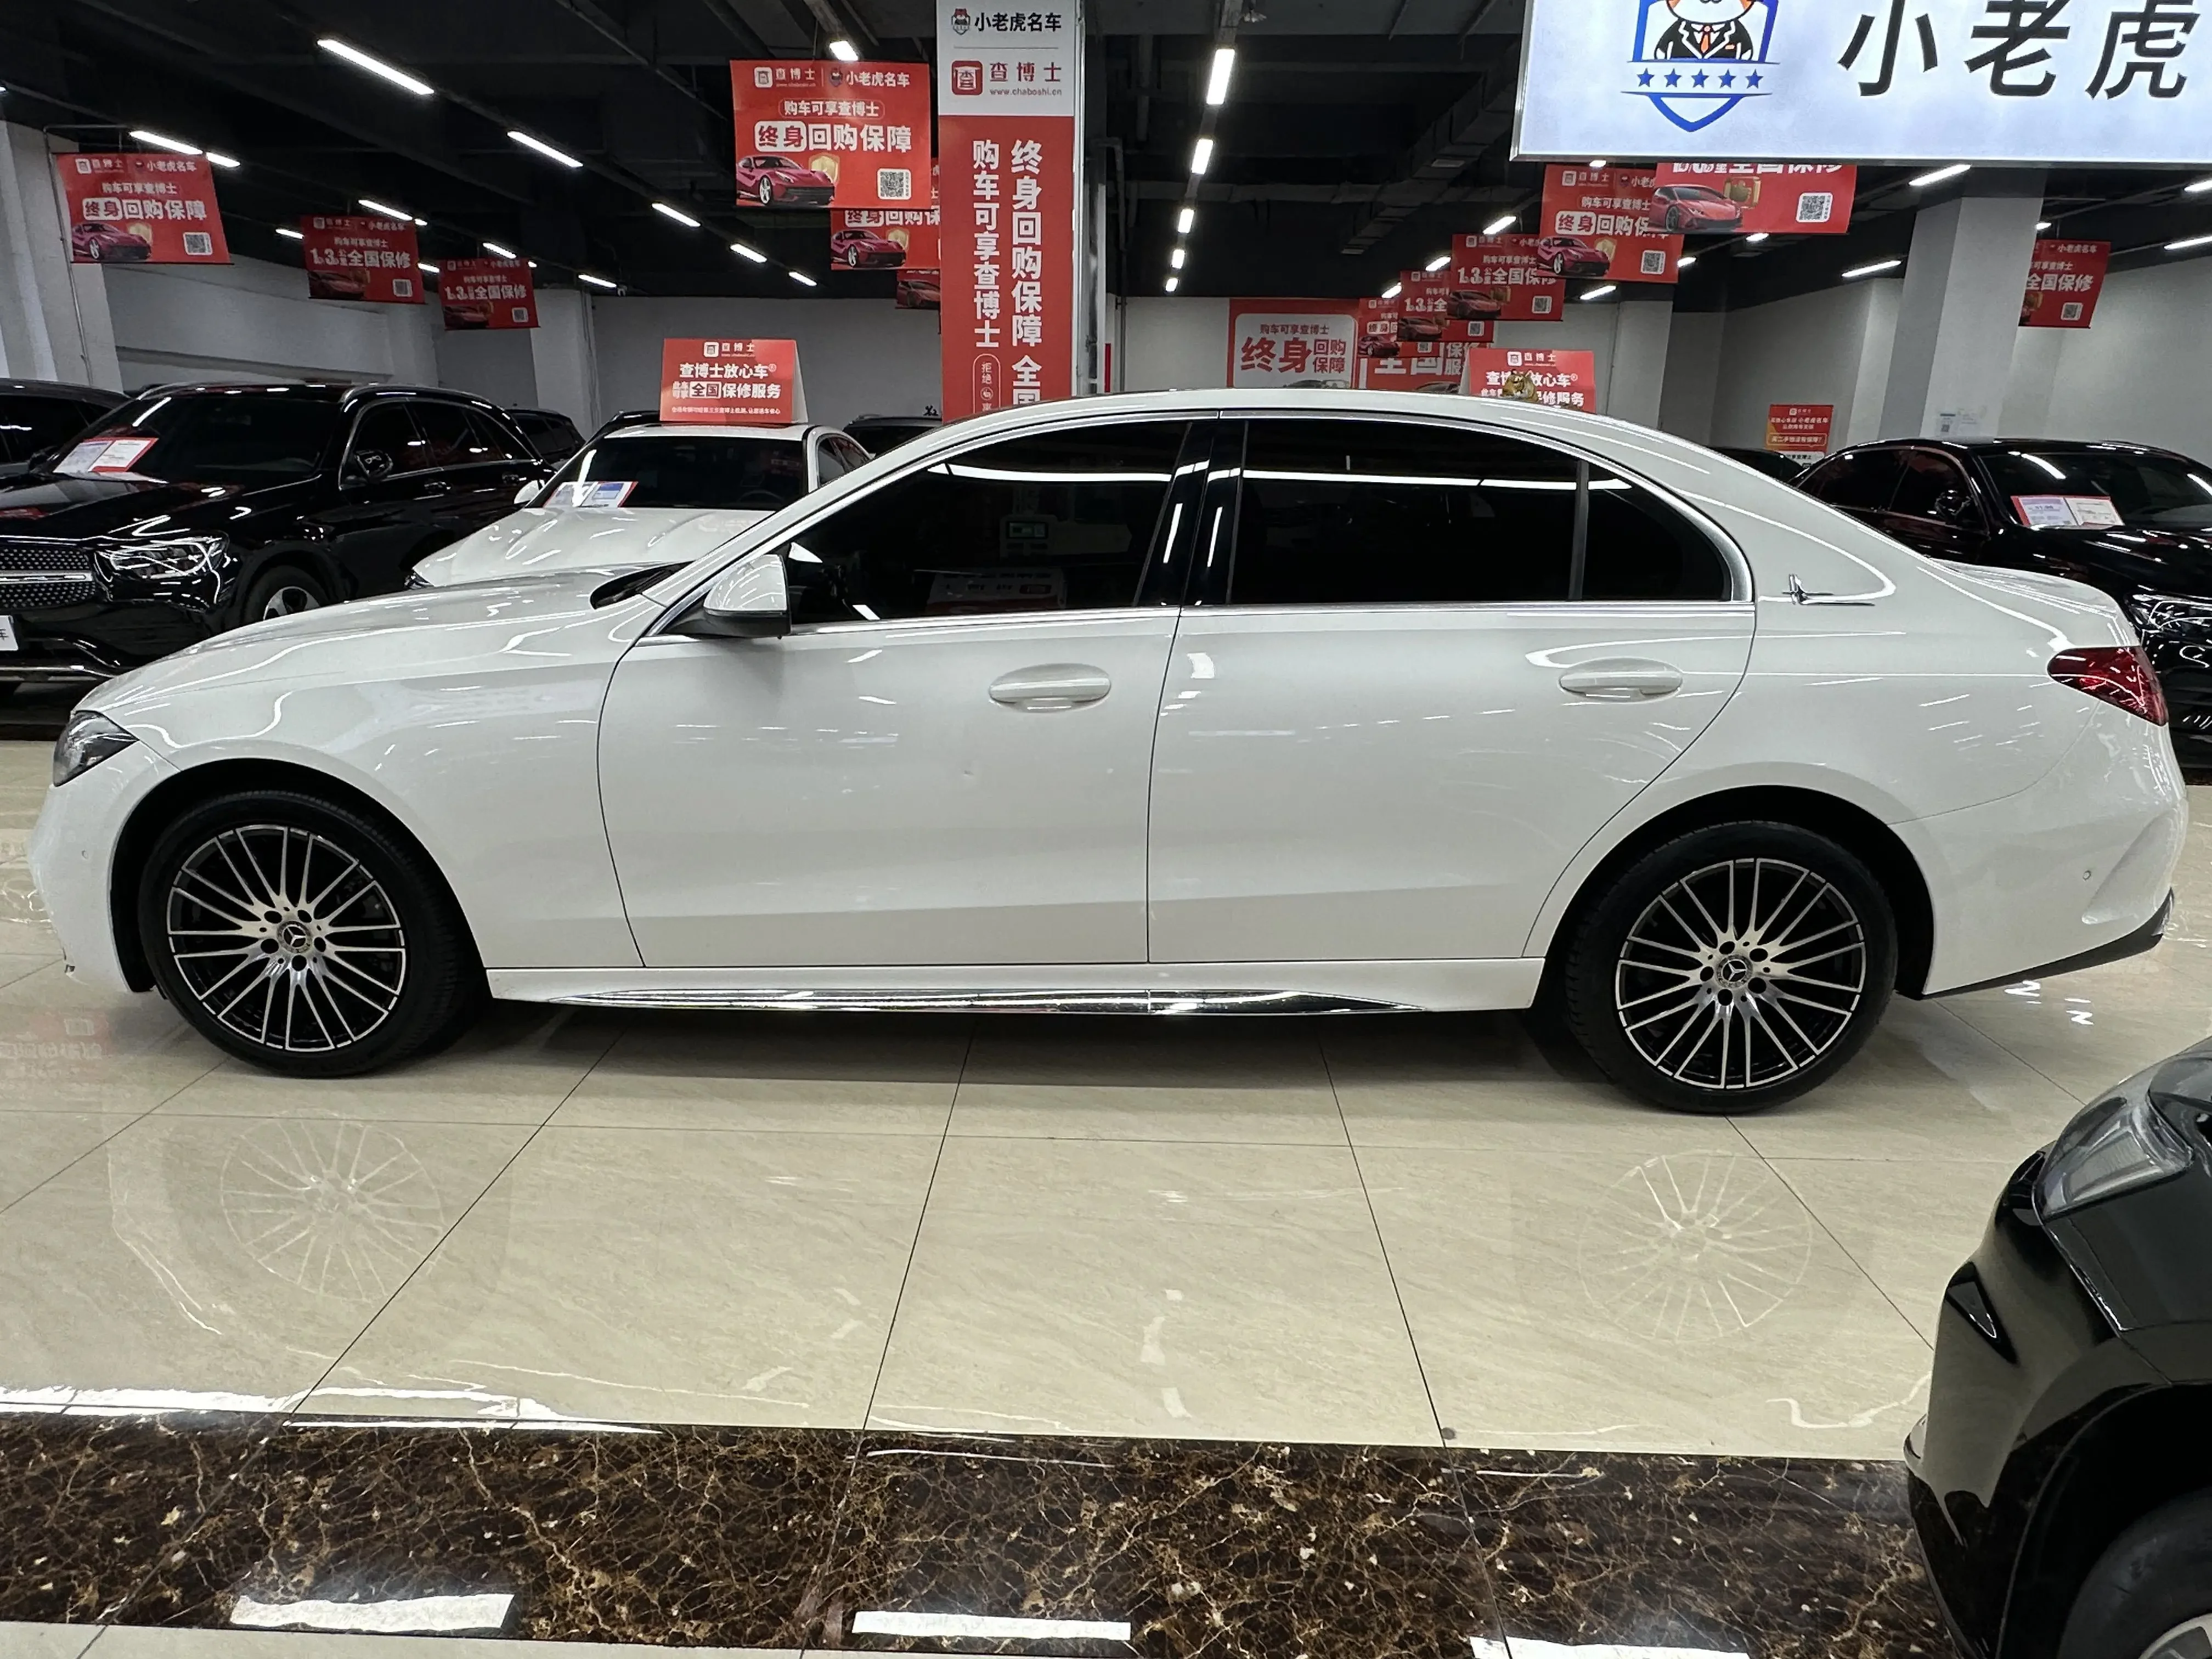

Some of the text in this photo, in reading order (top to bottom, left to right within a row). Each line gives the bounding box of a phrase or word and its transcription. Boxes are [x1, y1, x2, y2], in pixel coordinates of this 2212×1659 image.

[975, 12, 1062, 32] 小老虎名车
[1838, 0, 2200, 100] 小老虎
[846, 71, 910, 88] 小老虎名车
[990, 62, 1062, 82] 查博士
[785, 100, 879, 117] 购车可享查博士
[758, 123, 912, 153] 终身回购保障
[84, 199, 207, 221] 终身回购保障
[1582, 196, 1651, 211] 购车可享查博士
[1558, 215, 1669, 240] 终身回购保
[973, 139, 1000, 348] 购车可享查博士
[2027, 273, 2094, 292] 全国保修
[1241, 336, 1312, 373] 终身
[1313, 338, 1346, 356] 回购
[679, 363, 769, 379] 查博士放心车
[1312, 357, 1346, 374] 保障
